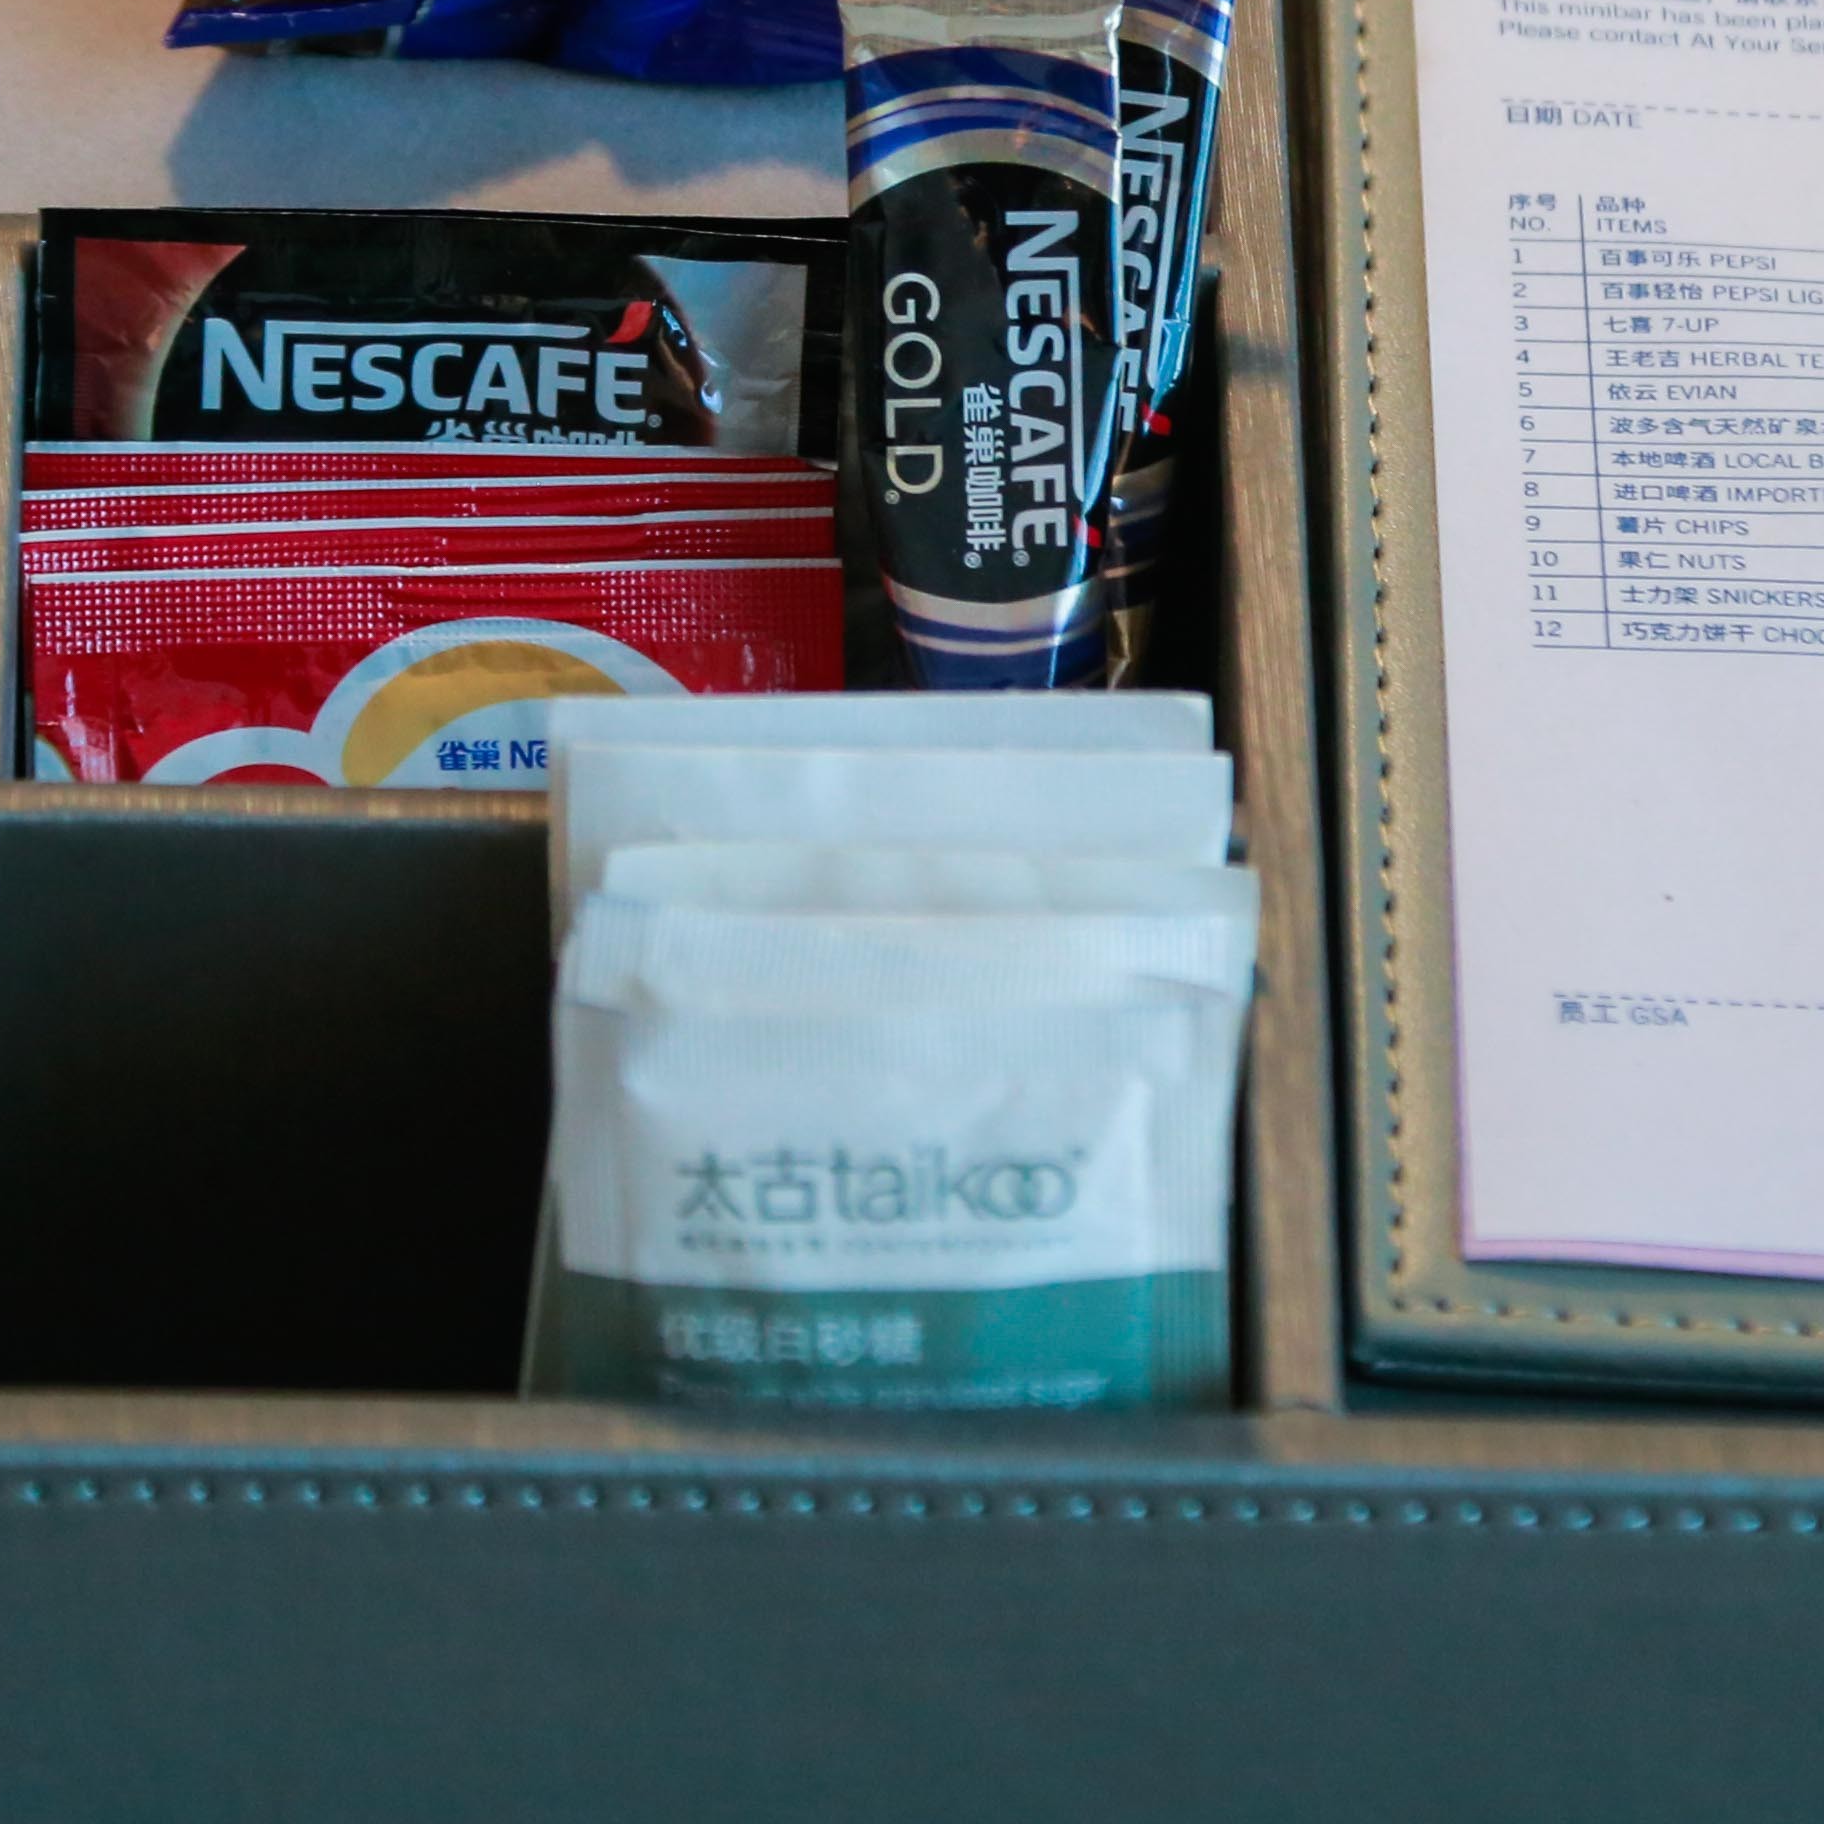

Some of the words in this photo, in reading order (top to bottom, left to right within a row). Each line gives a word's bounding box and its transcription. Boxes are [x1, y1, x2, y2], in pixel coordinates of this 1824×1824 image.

[1558, 2, 1652, 22] minibar
[1662, 6, 1706, 26] has
[1715, 9, 1777, 30] been
[1497, 19, 1581, 42] Please
[1589, 27, 1680, 49] contact
[1724, 34, 1782, 55] Your
[1505, 104, 1563, 127] 日期
[1573, 108, 1643, 130] DATE
[1508, 192, 1558, 213] 序号
[1595, 195, 1646, 214] 品种
[1509, 215, 1552, 234] NO.
[1596, 217, 1668, 235] ITEMS
[1512, 248, 1523, 266] 1
[1600, 248, 1701, 269] 百事可乐
[1710, 253, 1777, 271] PEPSI
[1512, 282, 1528, 299] 2
[1601, 281, 1703, 302] 百事轻怡
[1712, 285, 1779, 304] PEPSI
[1513, 315, 1530, 332] 3
[1603, 314, 1653, 335] 七喜
[1662, 316, 1720, 334] 7-UP
[1515, 348, 1530, 365] 4
[1606, 349, 1681, 369] 王老吉
[1689, 349, 1788, 369] HERBAL
[882, 271, 944, 496] GOLD
[1518, 381, 1533, 399] 5
[1607, 383, 1658, 402] 依云
[1666, 383, 1738, 401] EVIAN
[1520, 415, 1535, 432] 6
[962, 381, 1007, 552] 雀巢咖啡
[1521, 448, 1536, 465] 7
[1610, 450, 1716, 471] 本地啤酒
[1723, 452, 1801, 471] LOCAL
[1523, 481, 1540, 498] 8
[1612, 482, 1718, 504] 进口啤酒
[1525, 515, 1541, 533] 9
[1615, 515, 1665, 536] 薯片
[1675, 517, 1750, 537] CHIPS
[1528, 550, 1559, 568] 10
[1618, 550, 1671, 571] 果仁
[1677, 552, 1748, 572] NUTS
[1532, 585, 1559, 602] 11
[1619, 585, 1700, 606] 士力架
[1533, 620, 1563, 638] 12
[1620, 621, 1754, 644] 巧克力饼干
[435, 738, 502, 771] 雀巢
[1630, 1005, 1690, 1028] GSA
[676, 1149, 819, 1223] 太古
[829, 1142, 1076, 1223] taikoo
